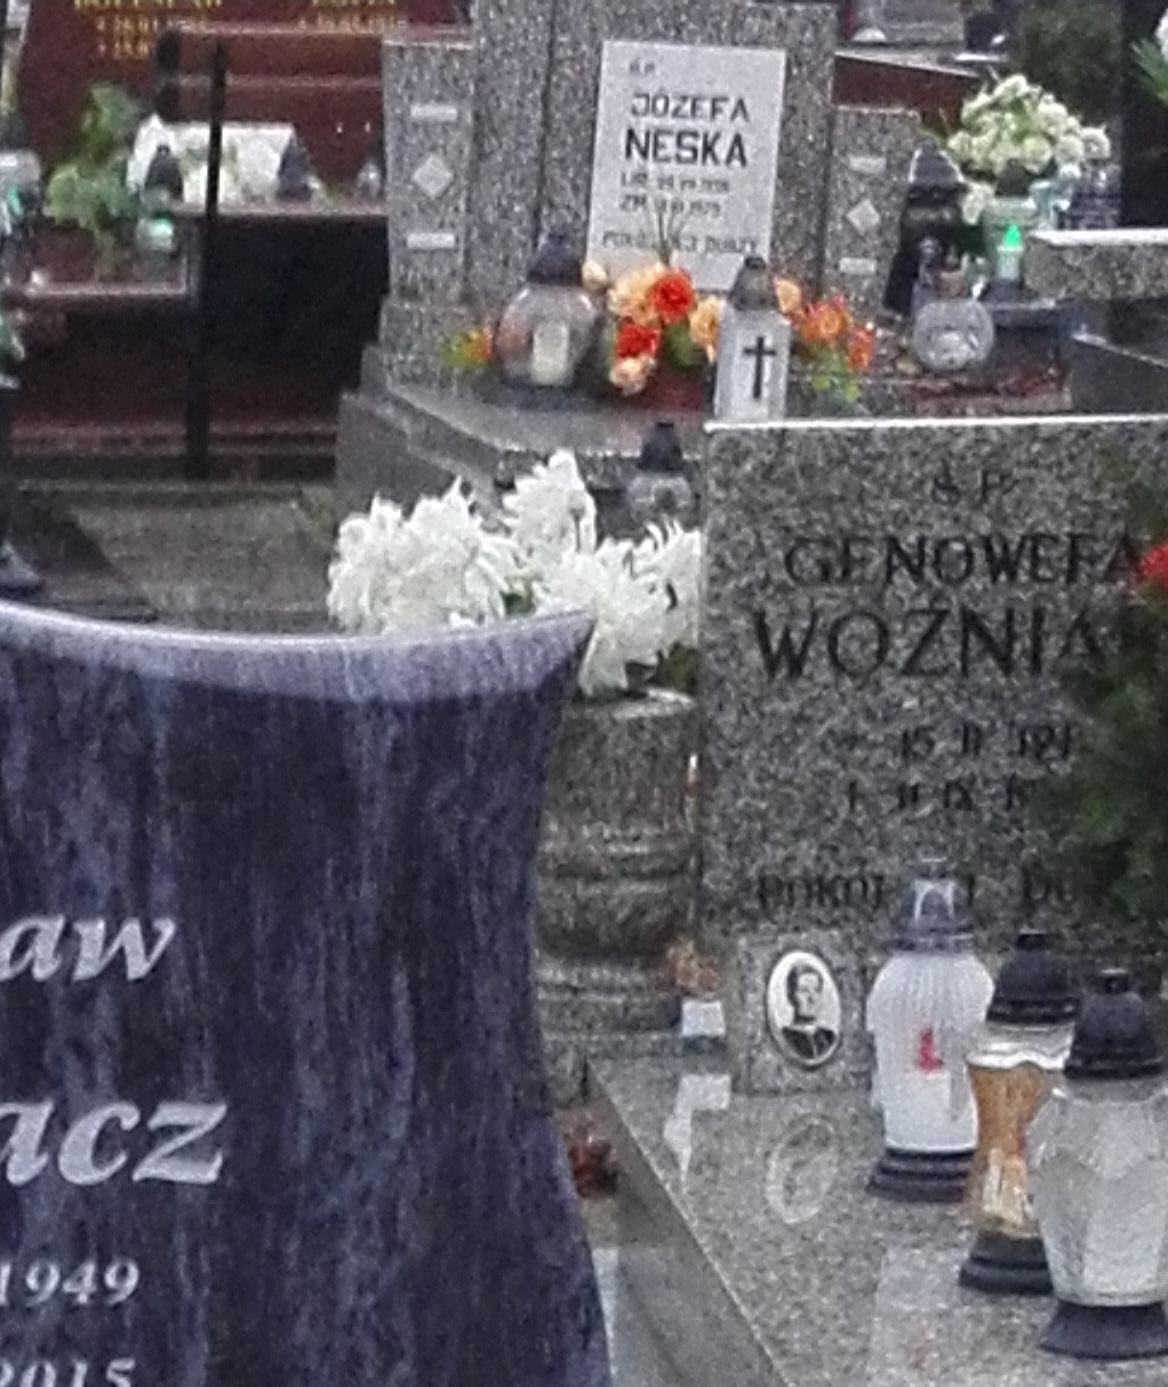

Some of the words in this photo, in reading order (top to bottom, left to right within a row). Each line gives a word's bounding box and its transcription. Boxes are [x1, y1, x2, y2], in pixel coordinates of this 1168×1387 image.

[631, 87, 751, 123] JÓZEFA
[625, 126, 748, 168] NESKA
[783, 530, 1144, 586] GENOWEFA
[752, 598, 1107, 681] WOŹNIA
